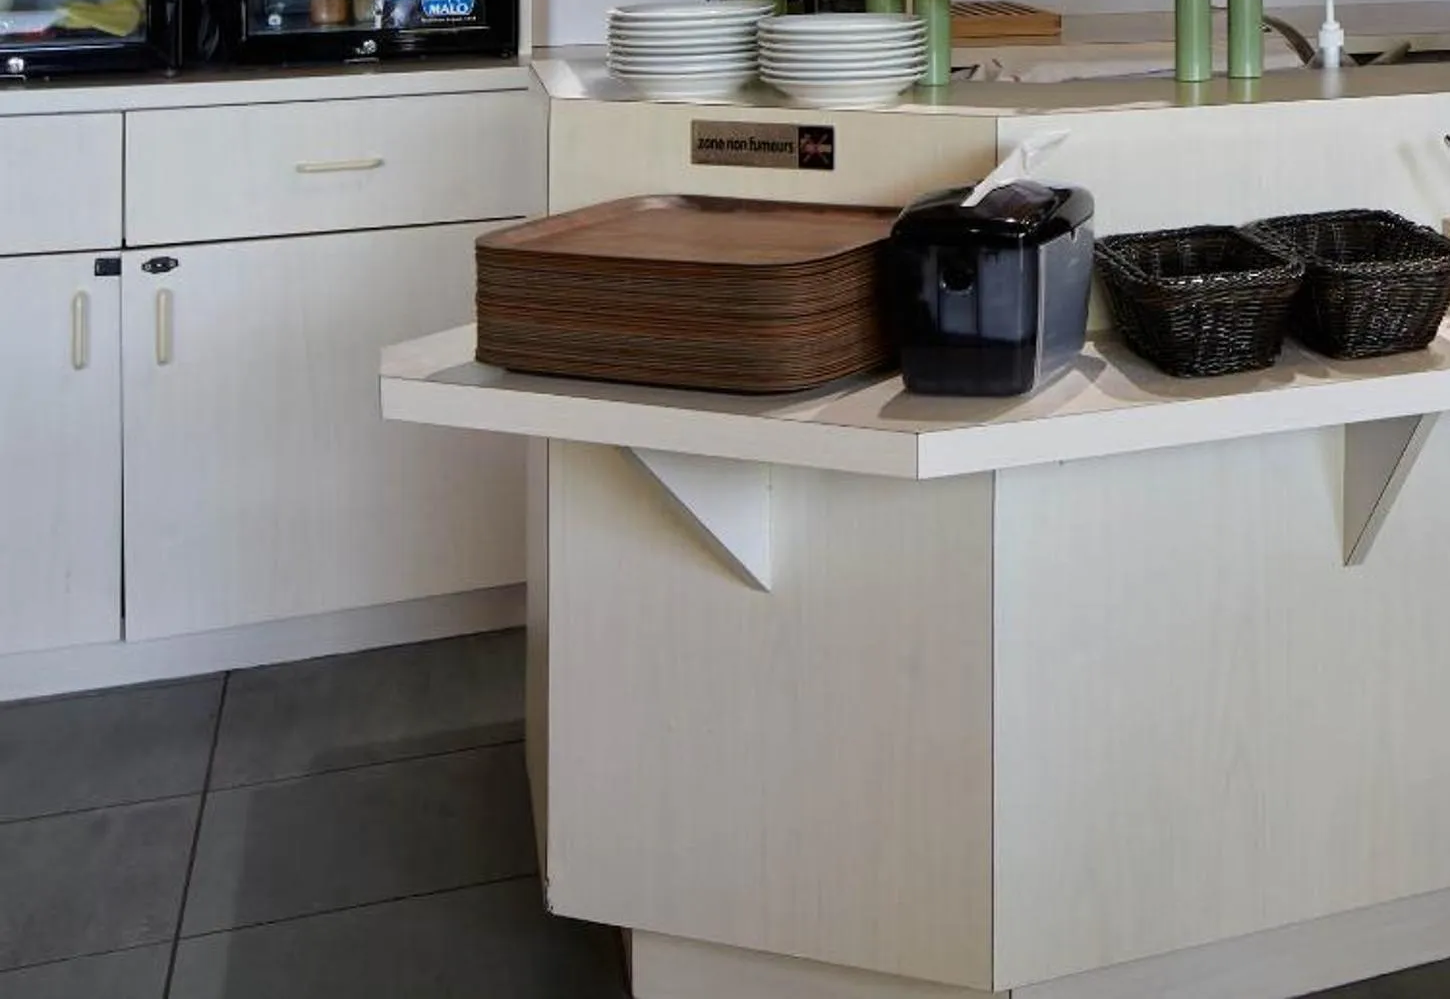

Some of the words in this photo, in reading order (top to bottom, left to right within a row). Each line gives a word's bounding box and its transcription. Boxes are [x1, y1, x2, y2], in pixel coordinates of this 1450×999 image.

[697, 137, 726, 151] zone
[726, 138, 748, 151] non
[749, 136, 795, 153] fumeurs
